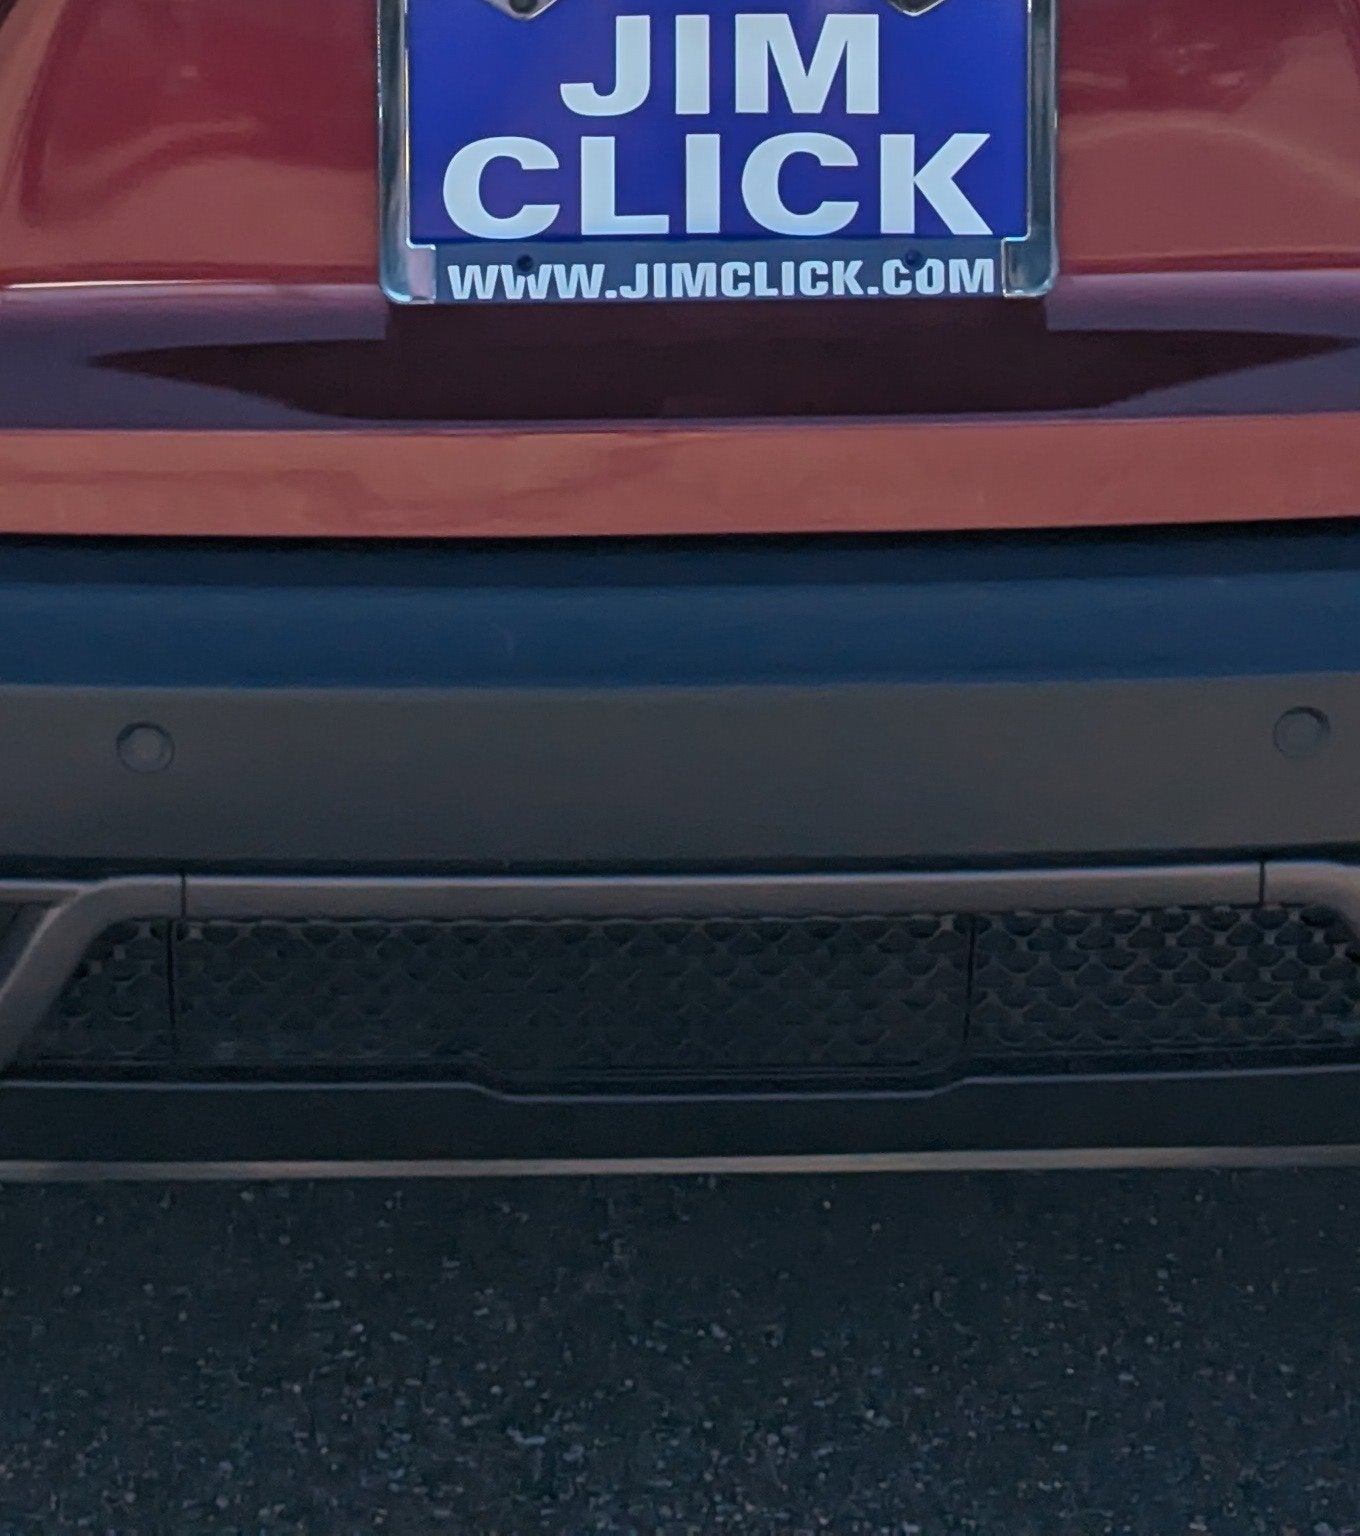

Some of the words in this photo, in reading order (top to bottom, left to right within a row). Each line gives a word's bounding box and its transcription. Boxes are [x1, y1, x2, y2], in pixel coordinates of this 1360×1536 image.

[560, 13, 879, 116] JIM
[443, 132, 993, 239] CLICK
[448, 258, 994, 300] WWW.JIMCLICK.COM
